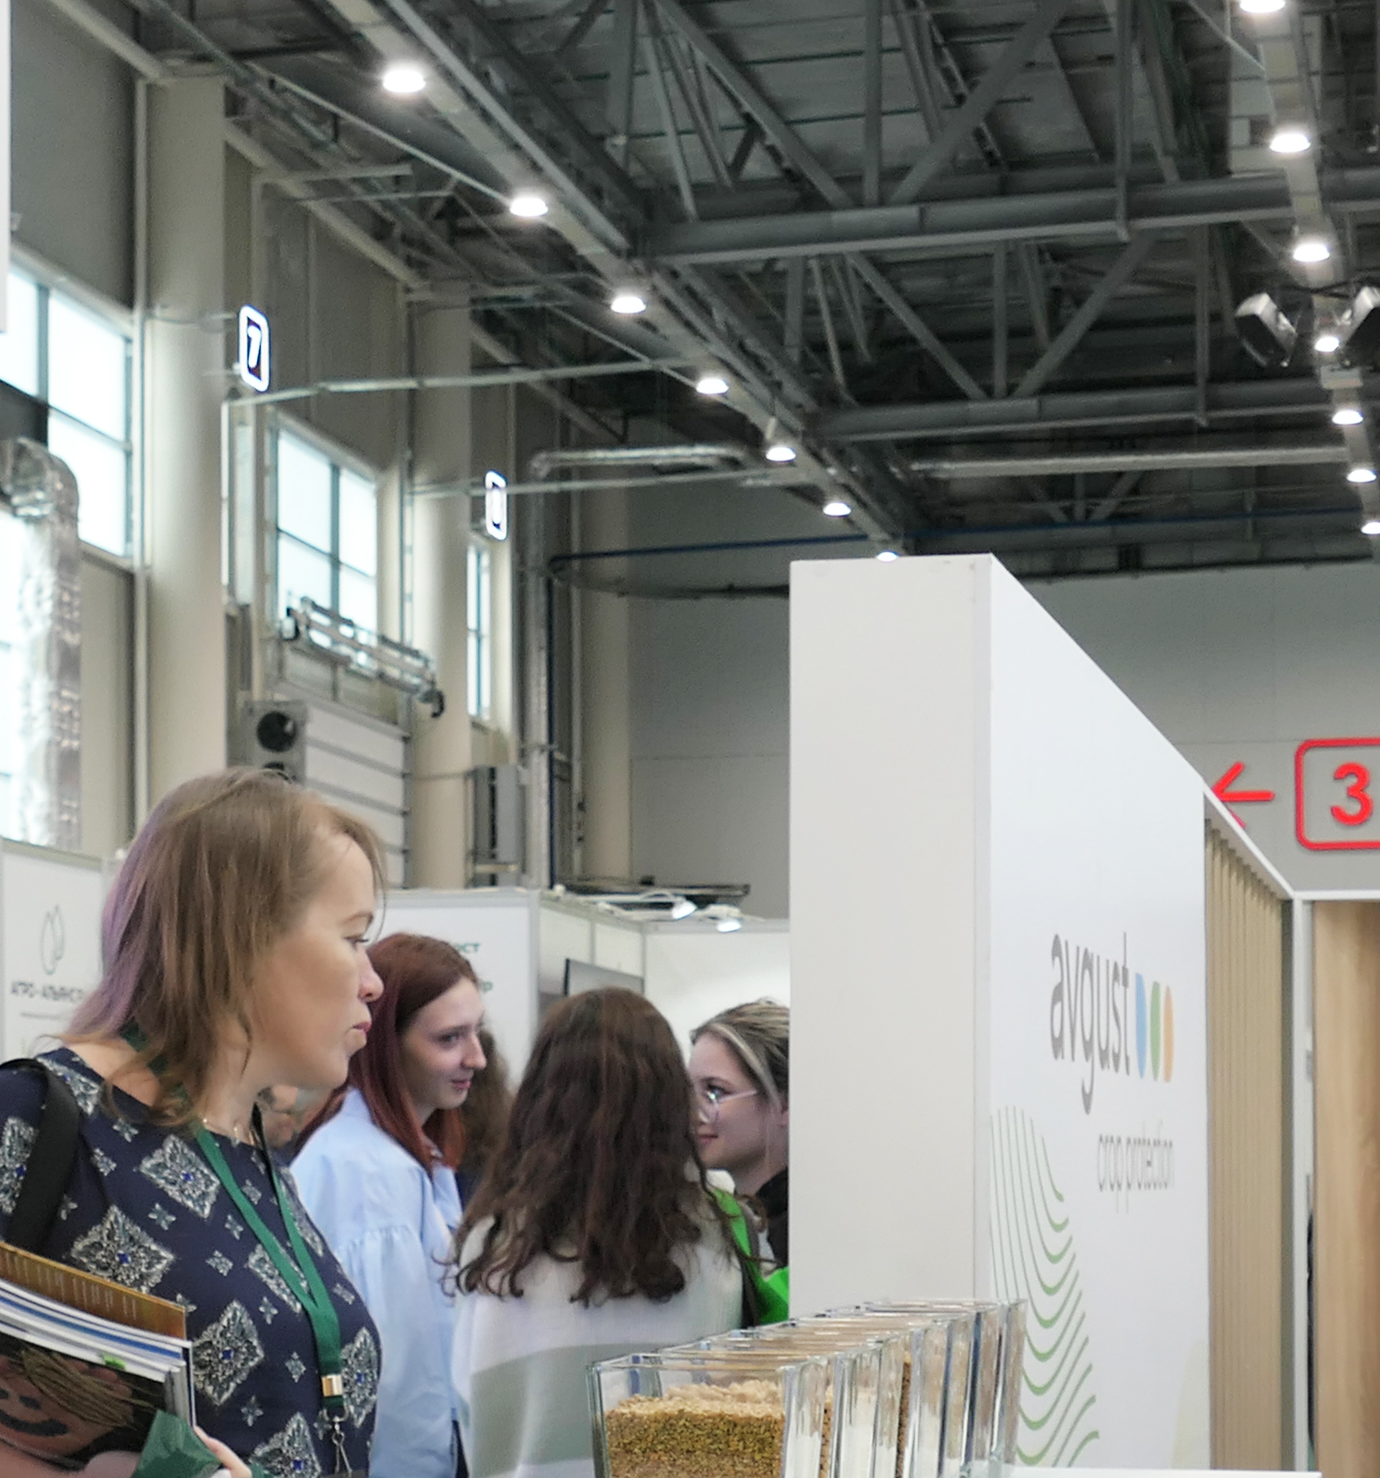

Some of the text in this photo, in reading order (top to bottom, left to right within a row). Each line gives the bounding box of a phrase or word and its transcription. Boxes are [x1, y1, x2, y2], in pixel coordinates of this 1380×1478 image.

[247, 325, 262, 369] 7
[1330, 762, 1377, 827] 3
[1049, 931, 1131, 1115] avgust
[1097, 1119, 1176, 1214] crop protection
